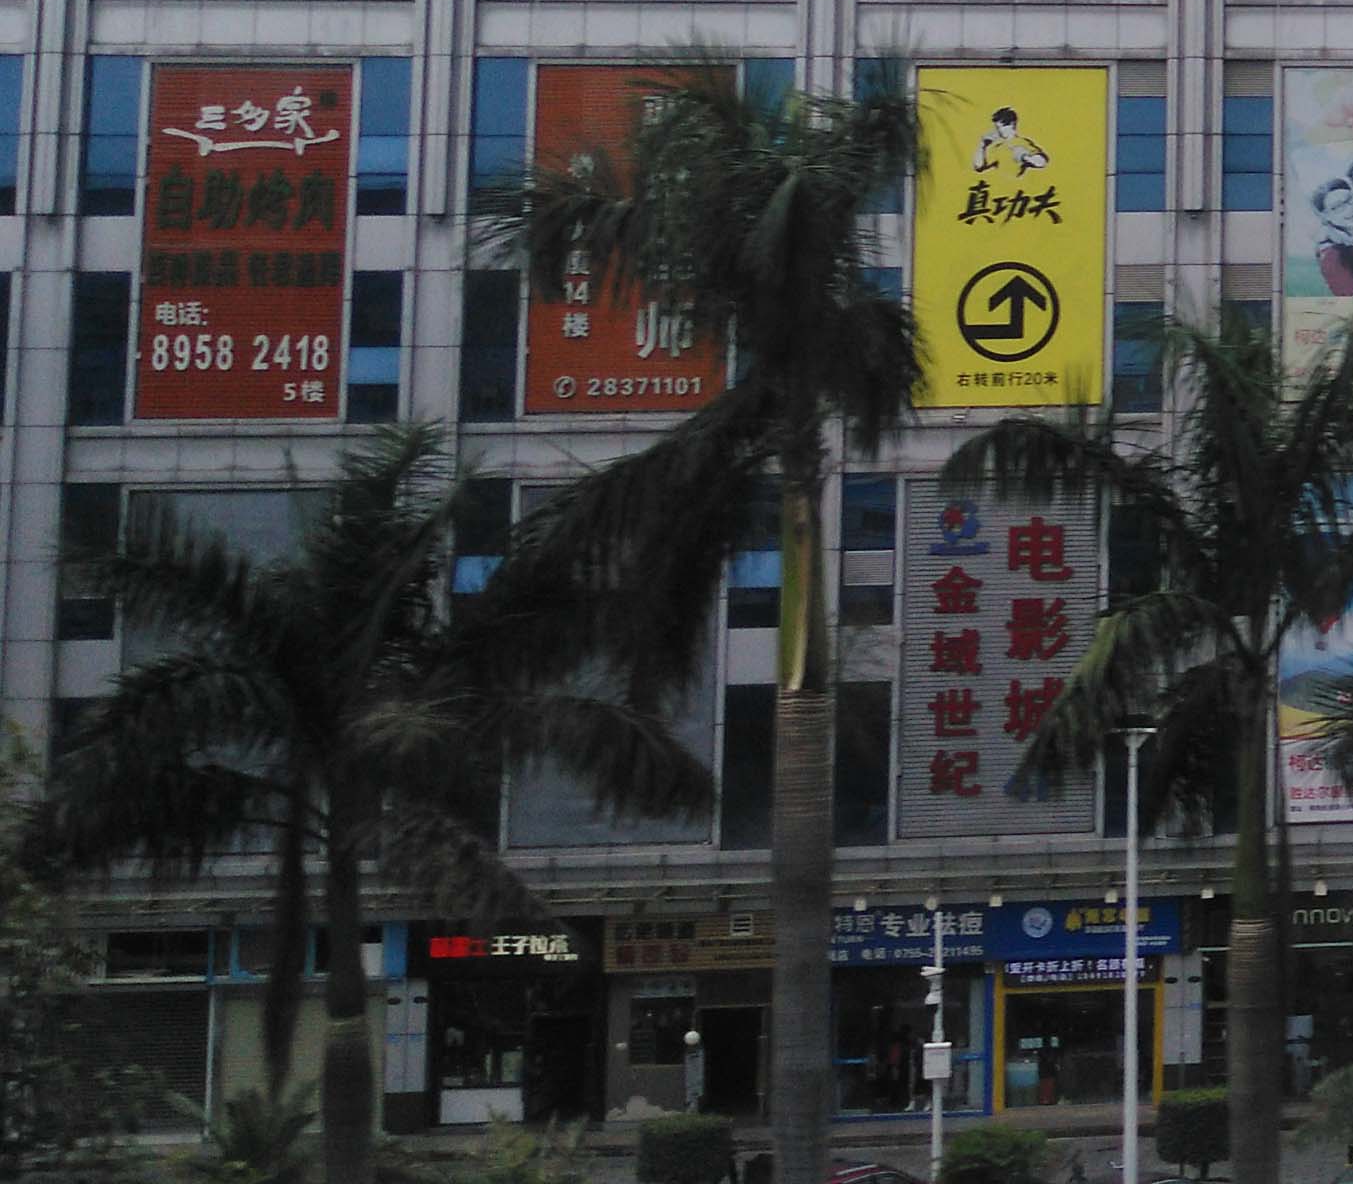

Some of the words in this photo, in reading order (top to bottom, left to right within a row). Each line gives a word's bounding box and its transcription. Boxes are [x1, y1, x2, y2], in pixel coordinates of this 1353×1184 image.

[957, 180, 1063, 226] 真功夫
[152, 334, 235, 372] 8958
[250, 334, 330, 372] 2418
[282, 380, 326, 403] 5楼
[587, 376, 703, 397] 28371101
[956, 370, 1060, 389] 右转前行20米
[1003, 516, 1073, 742] 电影城
[929, 565, 983, 798] 金域世纪
